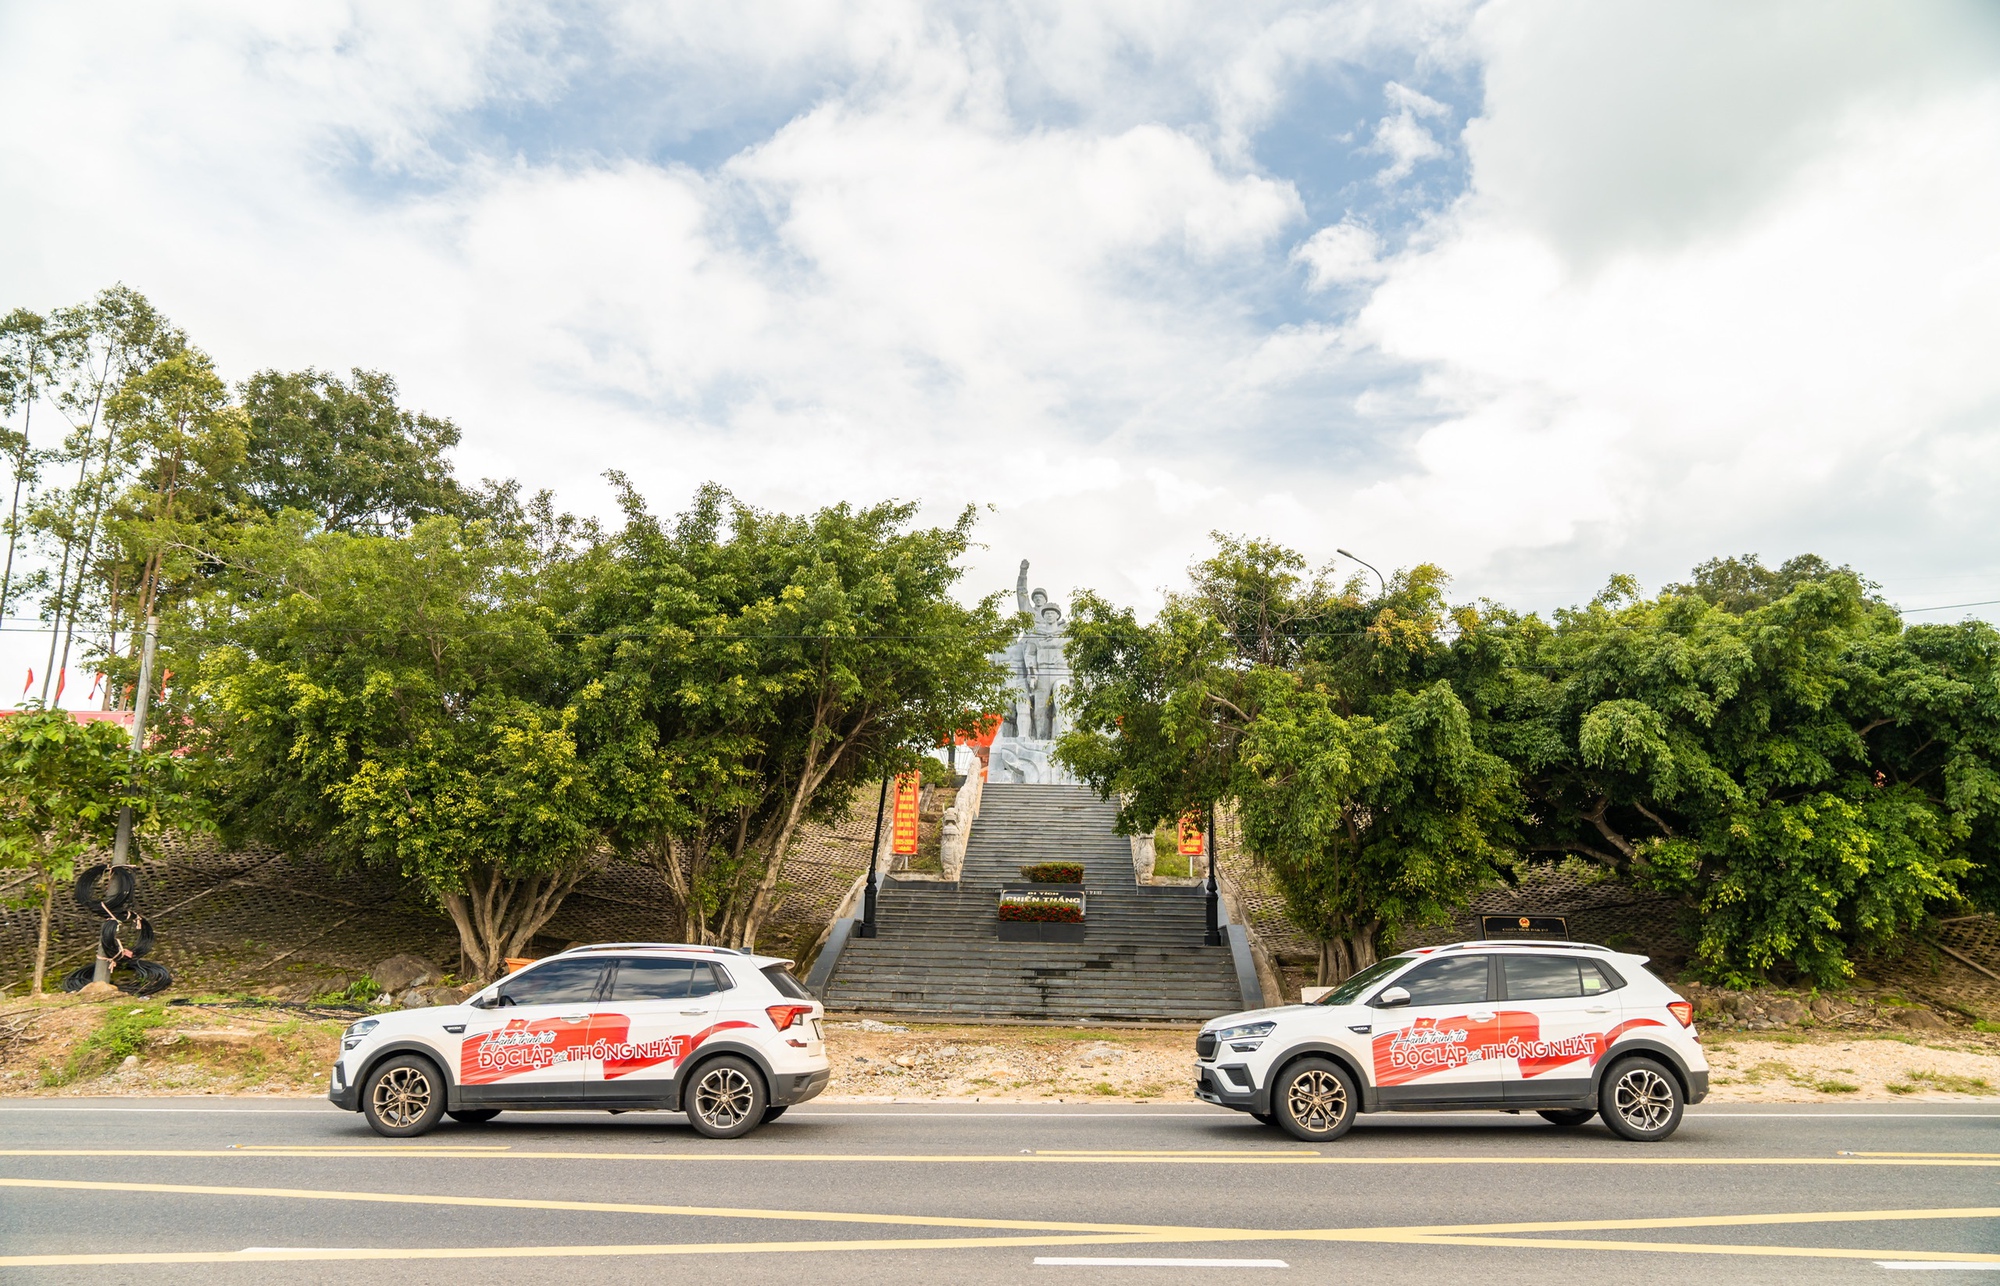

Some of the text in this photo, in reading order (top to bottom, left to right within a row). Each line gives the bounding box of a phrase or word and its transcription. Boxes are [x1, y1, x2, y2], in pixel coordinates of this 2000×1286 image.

[478, 1027, 556, 1052] Hành trình từ
[480, 1045, 521, 1071] ĐỘC
[521, 1044, 554, 1070] LẬP
[568, 1038, 633, 1062] THỐNG
[632, 1035, 683, 1060] NHẤT
[1390, 1026, 1469, 1051] Hành trình từ
[1392, 1046, 1435, 1070] ĐỘC
[1435, 1044, 1468, 1069] LẬP
[1482, 1036, 1547, 1061] THỐNG
[1546, 1033, 1597, 1057] NHẤT
